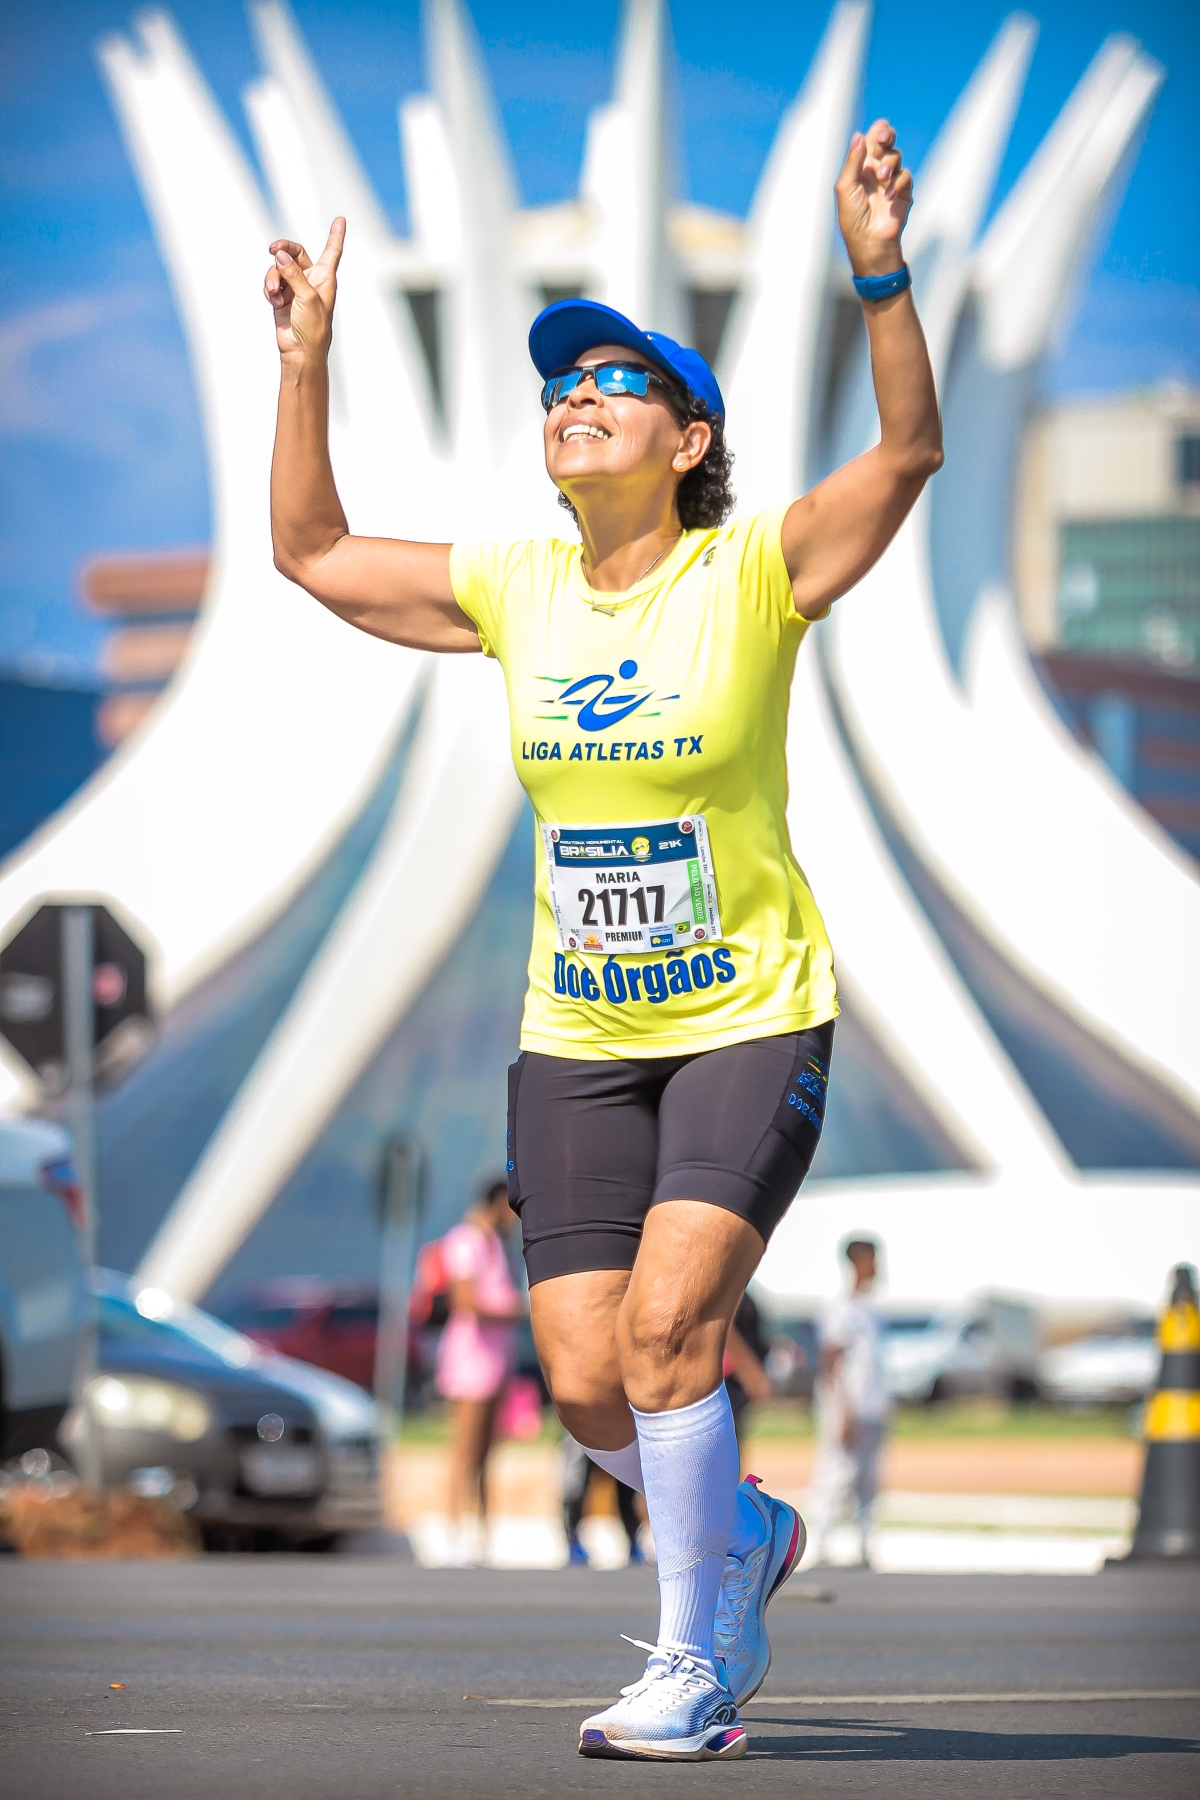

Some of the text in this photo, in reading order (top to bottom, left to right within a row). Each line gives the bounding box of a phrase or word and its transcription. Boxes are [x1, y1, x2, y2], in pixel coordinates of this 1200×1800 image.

[522, 734, 704, 761] LIGA ATLETAS TX
[658, 838, 683, 850] 21K
[595, 871, 641, 884] MARIA
[690, 863, 704, 922] PELOTÃO VERDE
[577, 884, 665, 927] 21717
[554, 947, 737, 1004] Doe Órgãos
